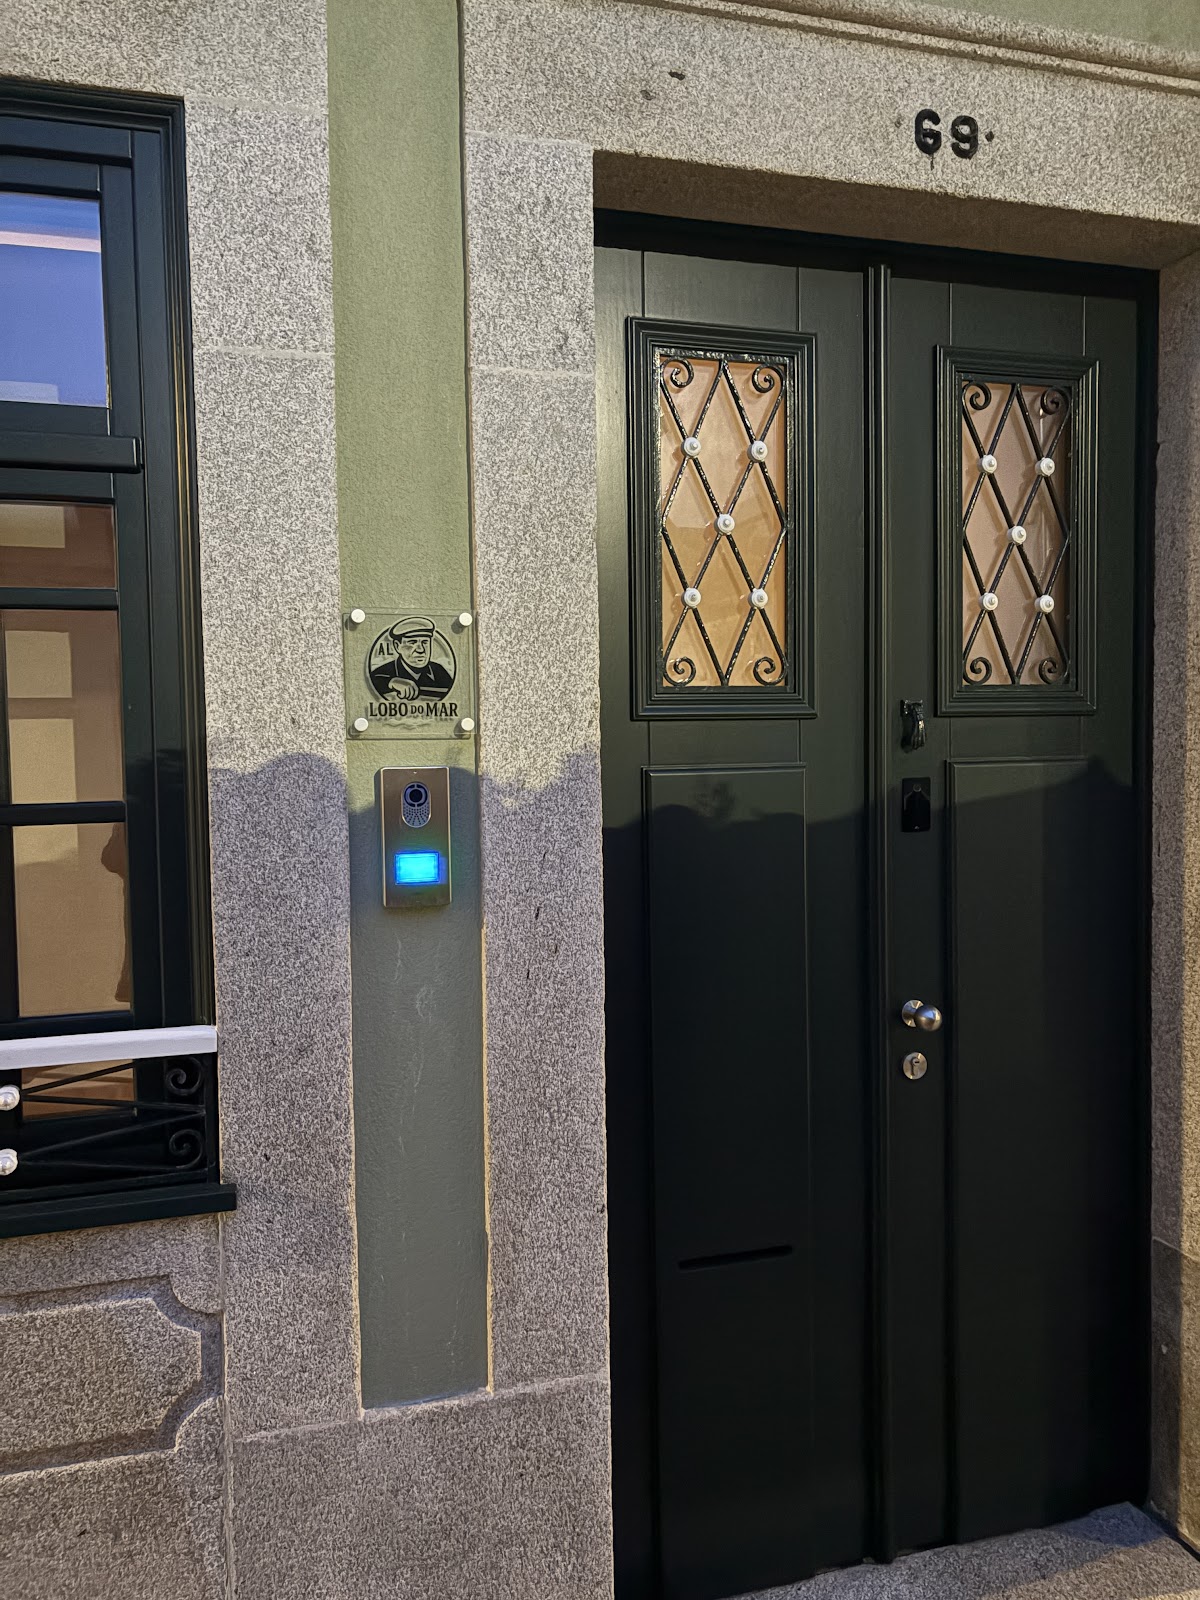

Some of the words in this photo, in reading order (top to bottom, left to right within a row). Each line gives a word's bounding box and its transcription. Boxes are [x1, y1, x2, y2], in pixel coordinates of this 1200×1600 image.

[914, 108, 979, 160] 69
[378, 642, 394, 656] AL
[369, 702, 408, 717] LOBO
[425, 702, 459, 717] MAR
